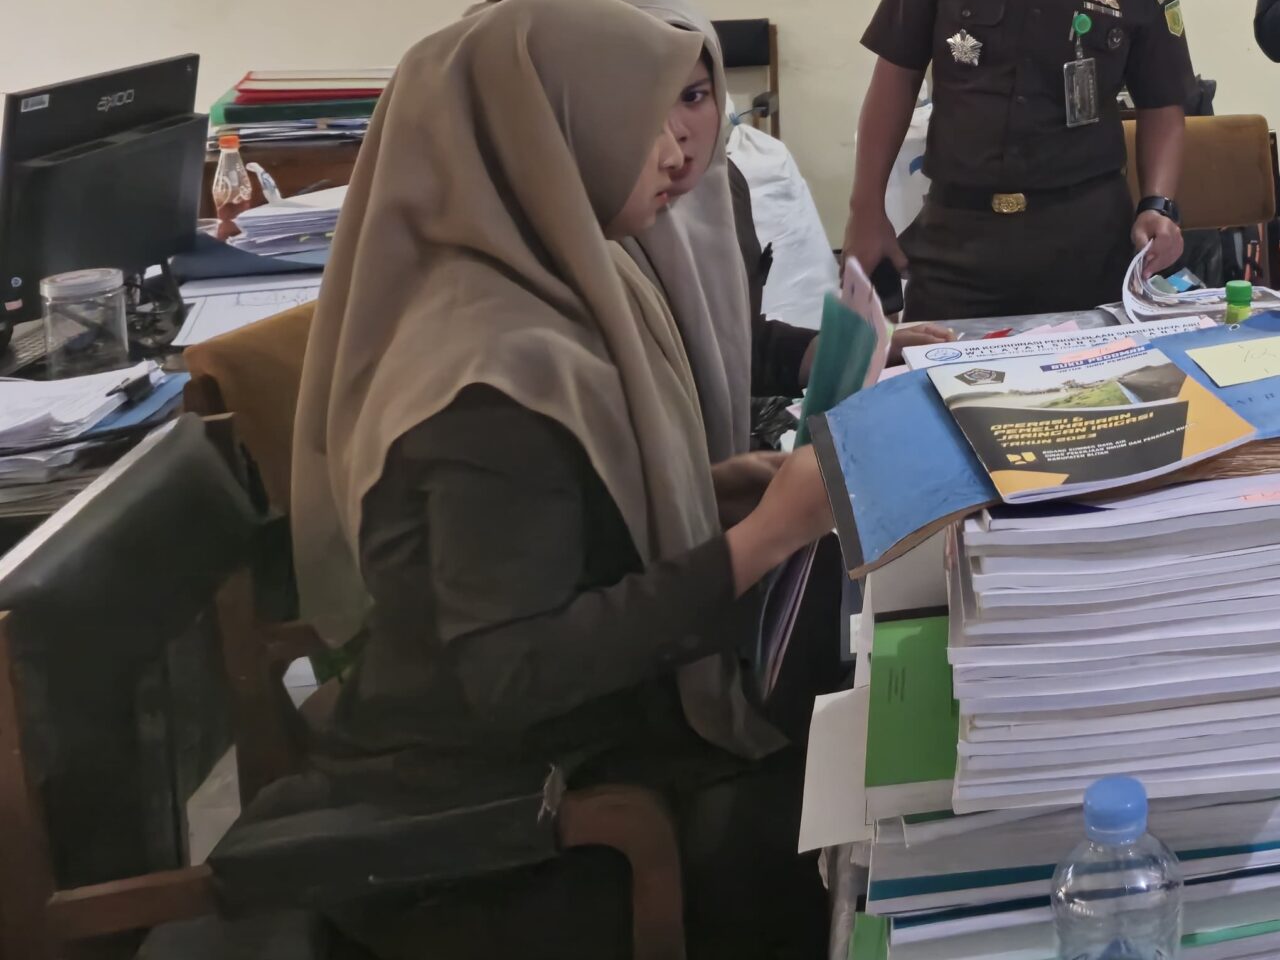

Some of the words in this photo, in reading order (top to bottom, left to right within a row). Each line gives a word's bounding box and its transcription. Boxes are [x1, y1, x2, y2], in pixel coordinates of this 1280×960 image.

[1051, 358, 1084, 370] BUKU
[1088, 346, 1146, 364] PEDOMAN
[990, 417, 1068, 431] OPERASI
[993, 412, 1132, 436] PEMELIHARAAN
[997, 427, 1086, 442] JARINGAN
[1091, 411, 1154, 430] IRIGASI
[1001, 438, 1052, 448] TAHUN
